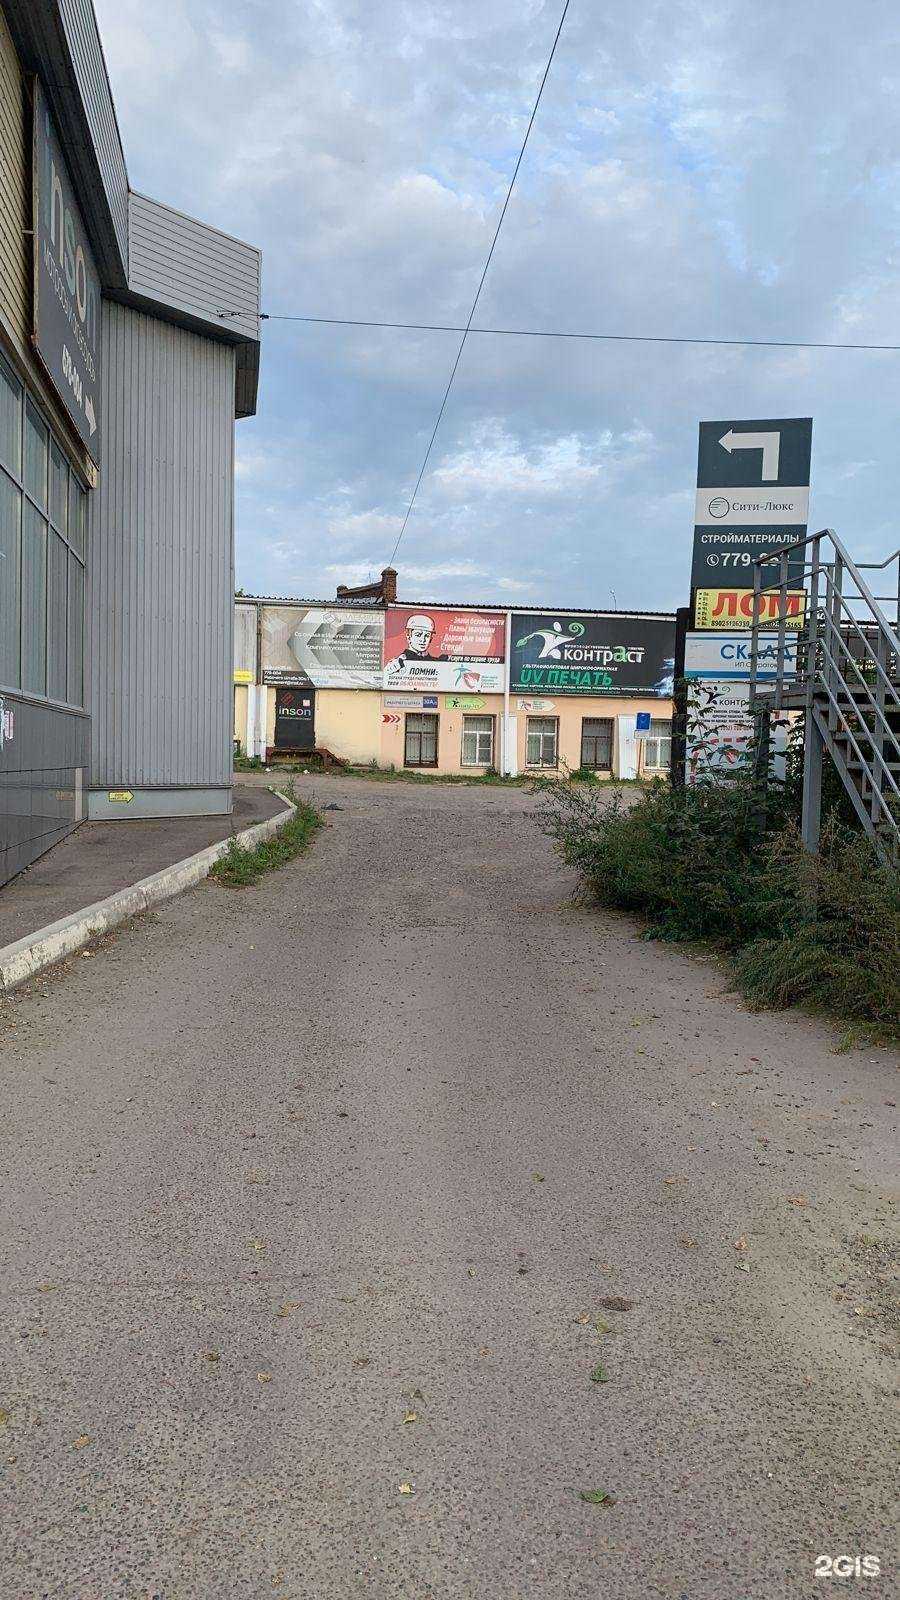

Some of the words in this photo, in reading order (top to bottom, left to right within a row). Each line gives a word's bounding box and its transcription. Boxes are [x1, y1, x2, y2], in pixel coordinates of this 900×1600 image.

[731, 501, 794, 511] Сити-Люкс
[701, 532, 799, 544] СТРОЙМАТЕРИАЛЫ
[712, 592, 800, 617] ЛОМ
[409, 668, 440, 676] ПОМНИ:
[520, 669, 546, 684] UV
[548, 670, 612, 686] ПЕЧАТЬ
[279, 706, 311, 716] inson
